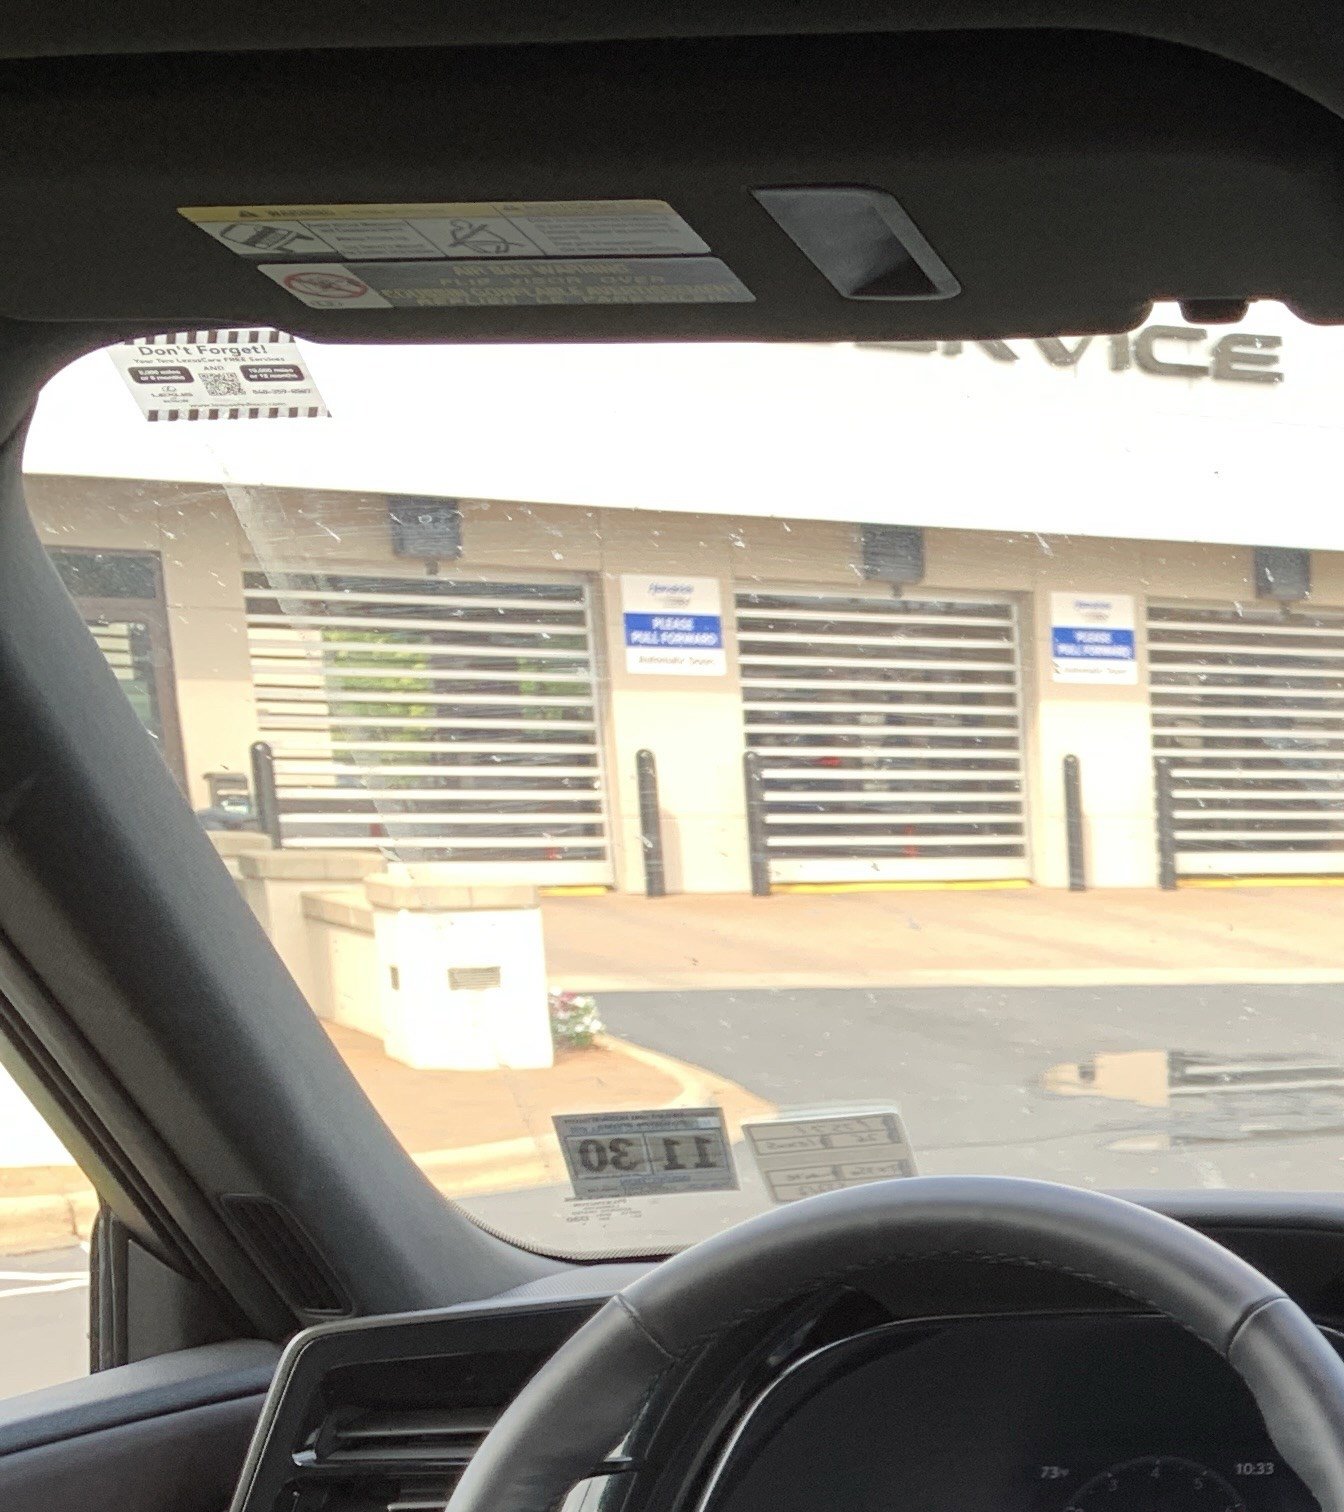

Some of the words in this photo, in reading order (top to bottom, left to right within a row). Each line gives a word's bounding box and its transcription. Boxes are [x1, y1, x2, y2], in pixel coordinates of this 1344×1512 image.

[138, 345, 193, 356] Don't
[196, 344, 268, 356] Forget!
[660, 631, 719, 647] FORWARD
[1235, 1462, 1276, 1476] 10:33
